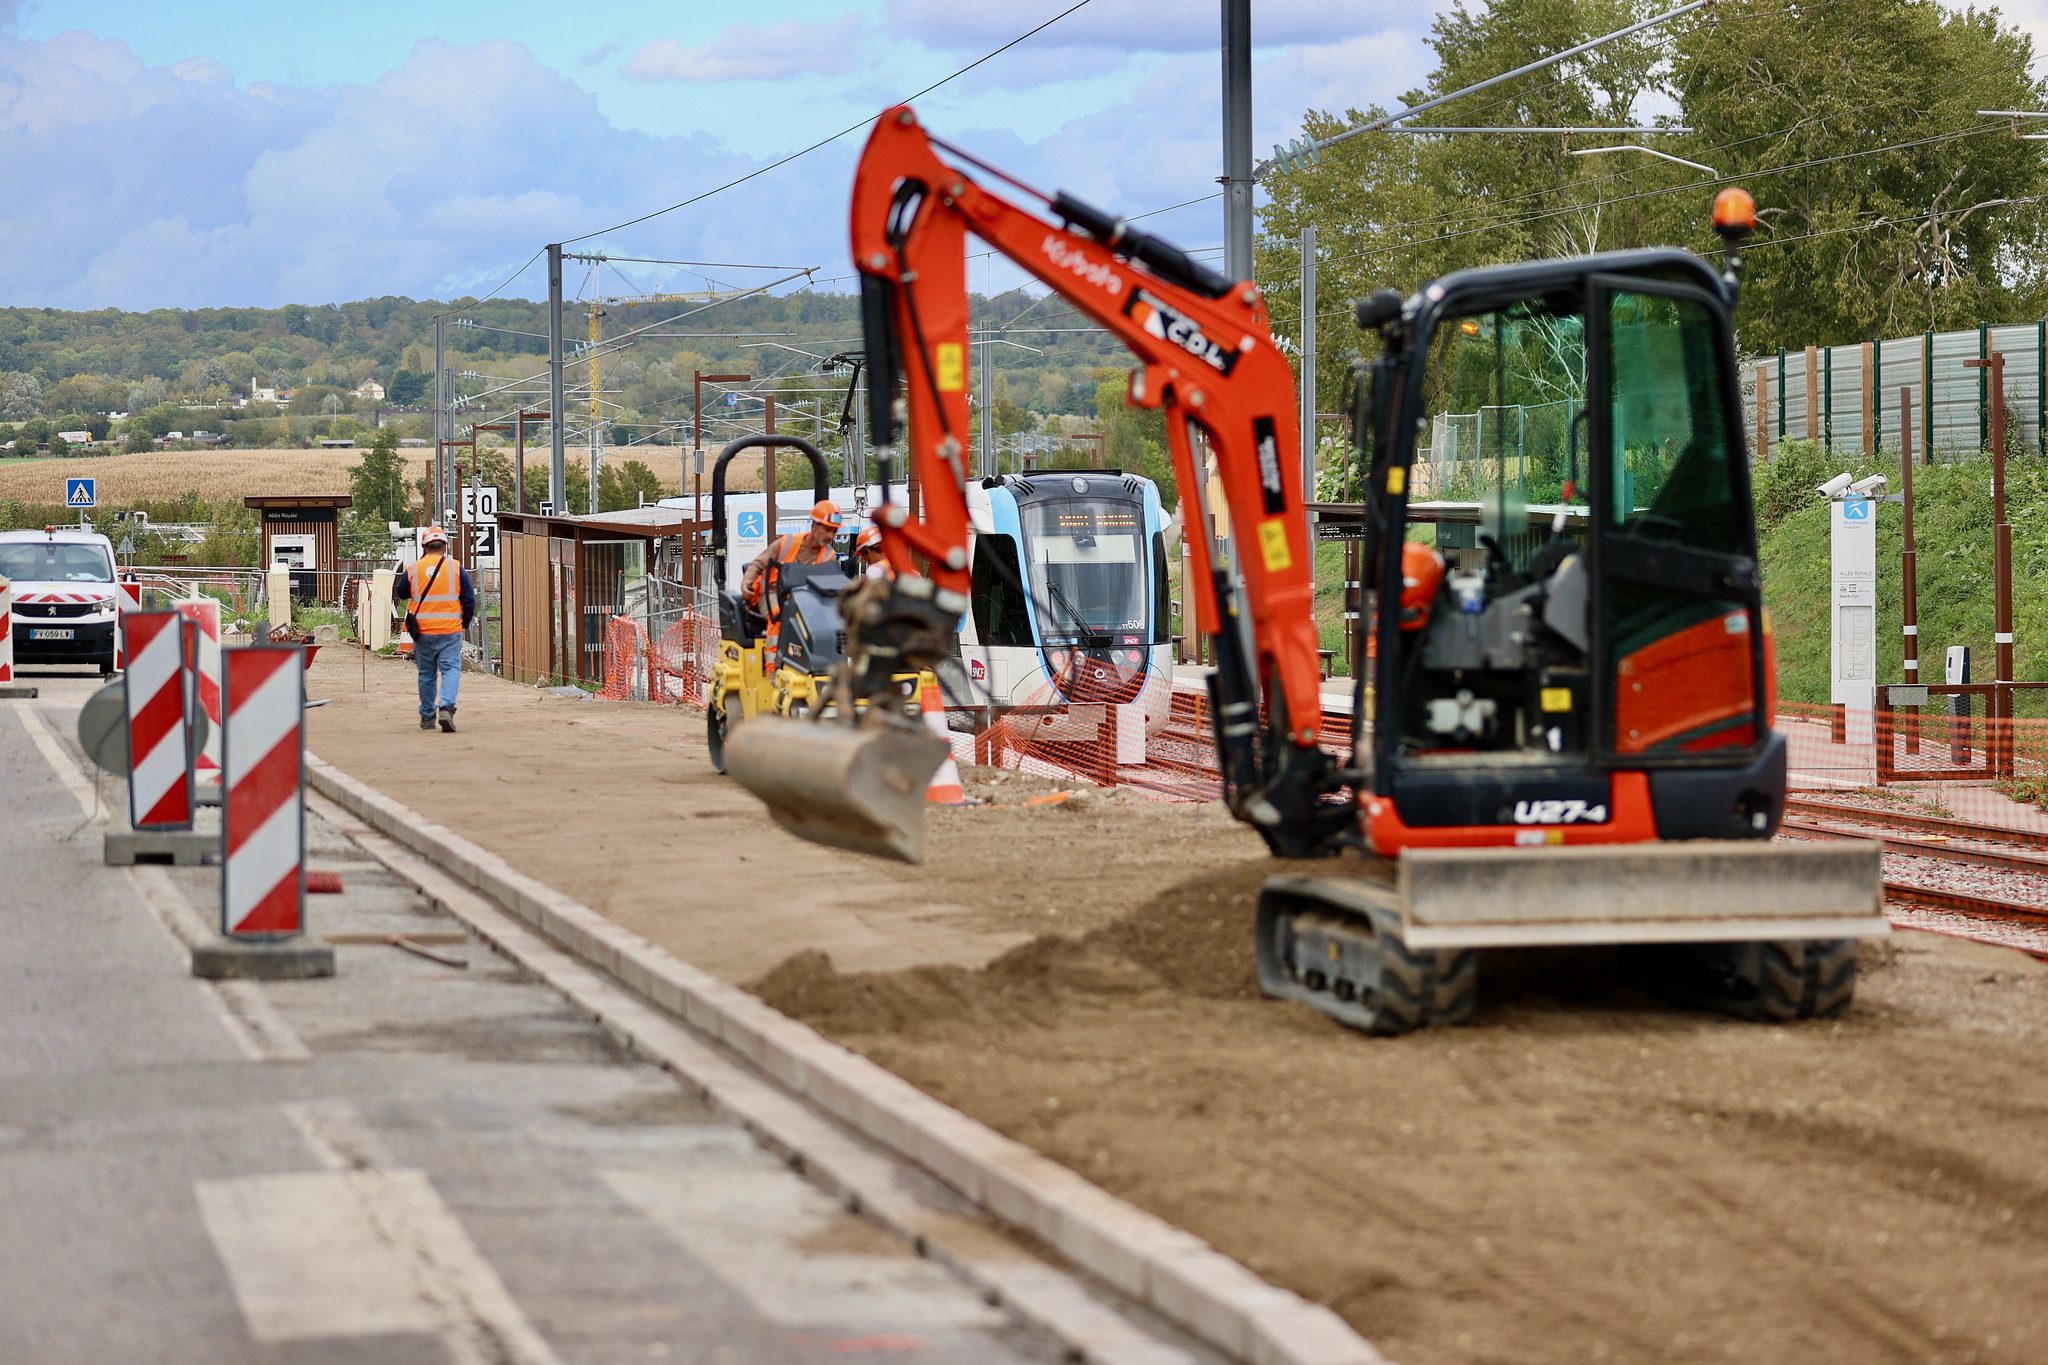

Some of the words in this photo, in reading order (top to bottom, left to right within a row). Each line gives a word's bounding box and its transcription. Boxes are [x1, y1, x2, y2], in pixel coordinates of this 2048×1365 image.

[467, 495, 492, 515] 30
[972, 667, 985, 677] SNCF
[1514, 800, 1607, 824] U27-4
